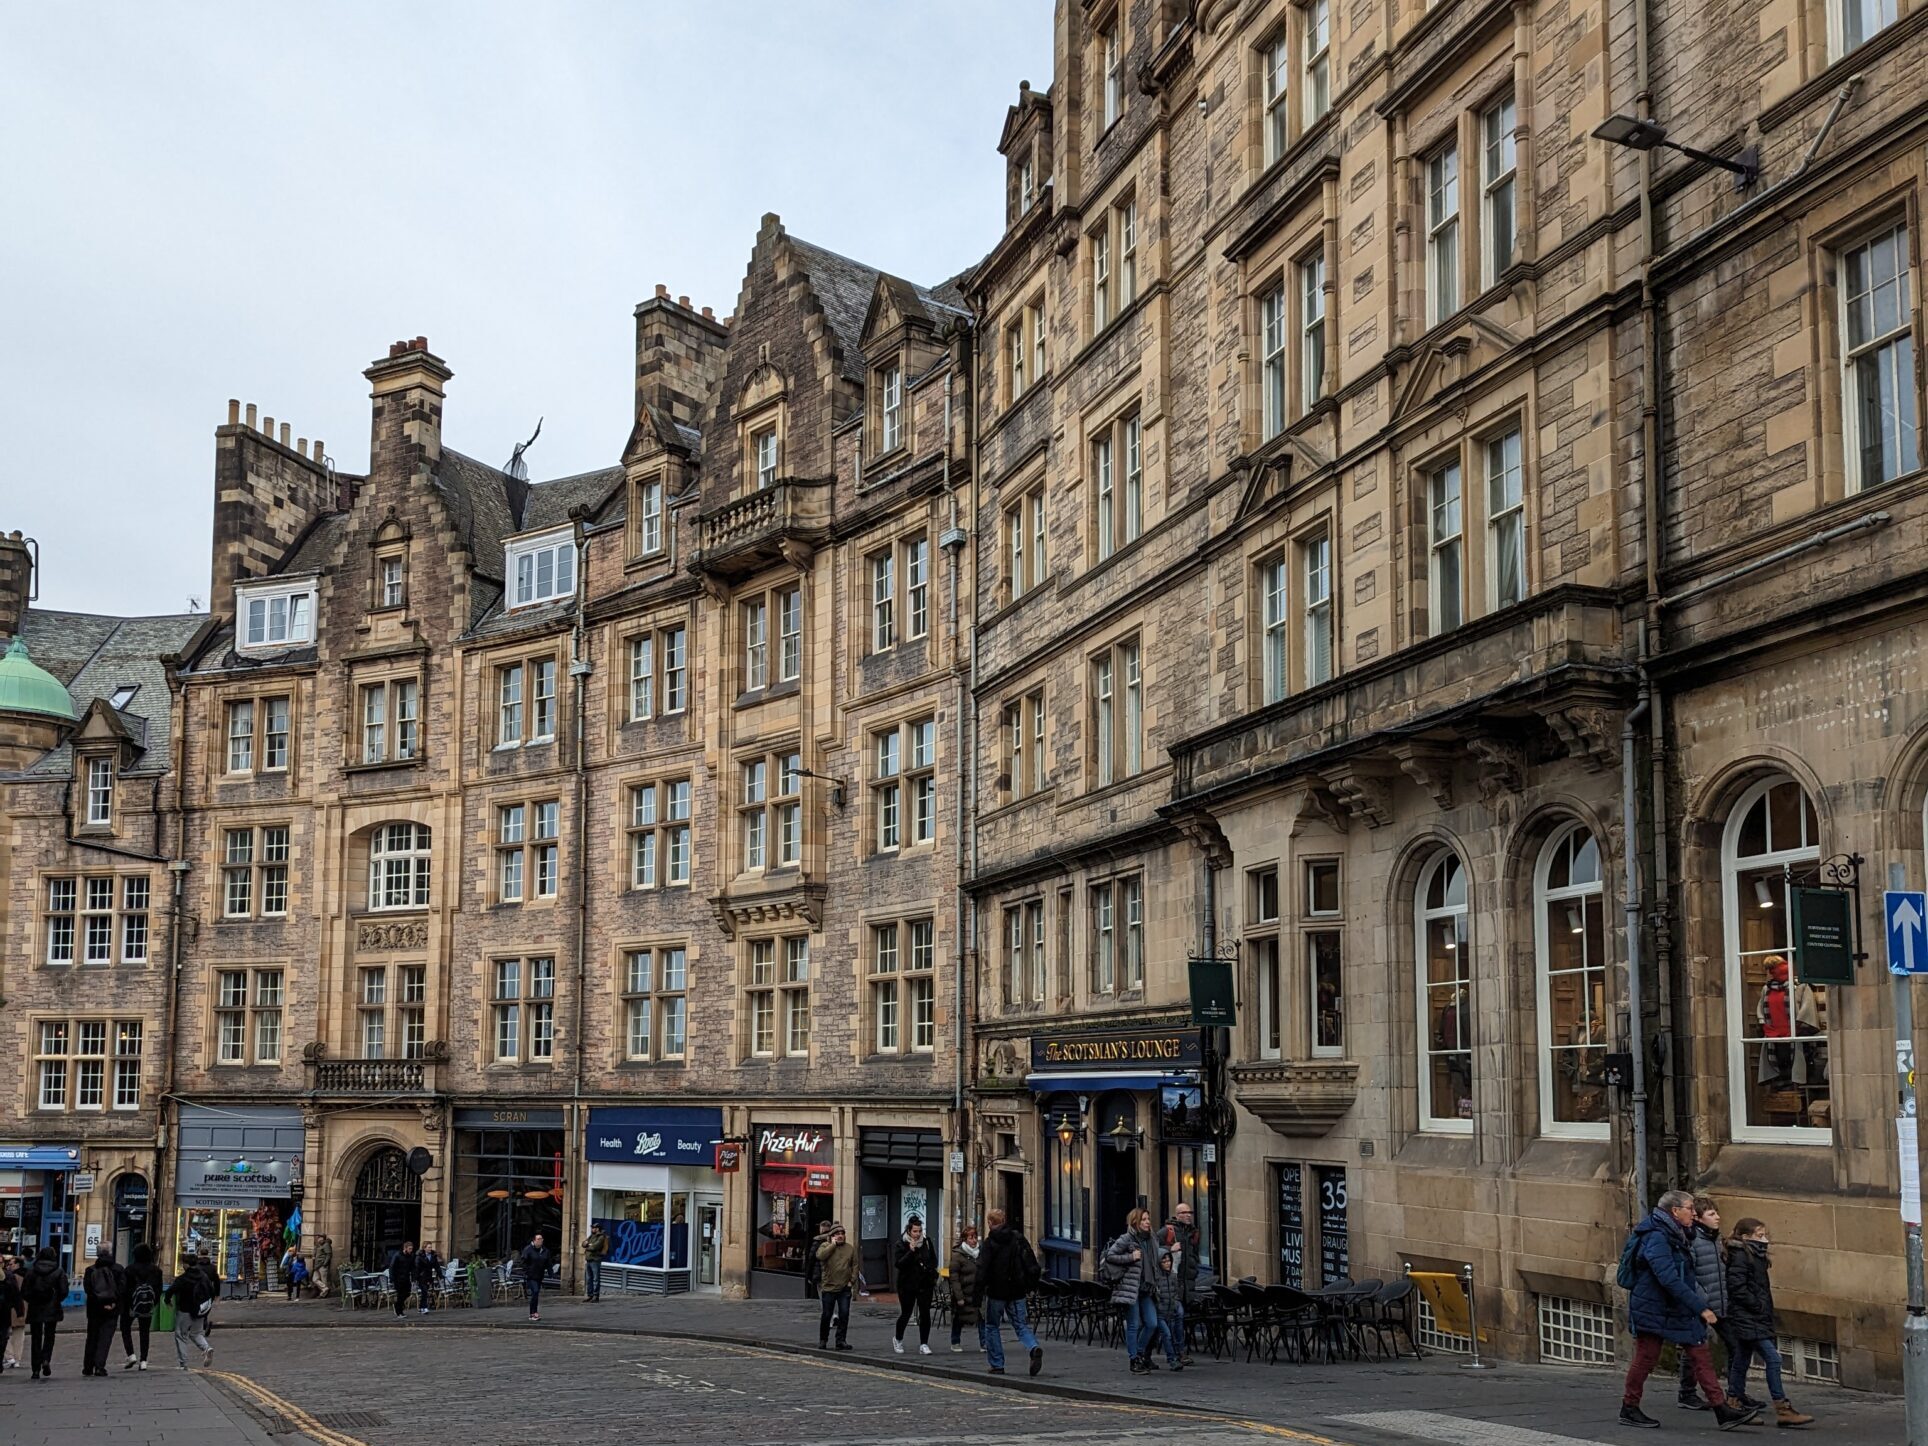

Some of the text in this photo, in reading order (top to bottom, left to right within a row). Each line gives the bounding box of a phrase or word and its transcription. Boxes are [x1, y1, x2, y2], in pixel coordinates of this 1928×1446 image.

[1046, 1039, 1181, 1061] The SCOTSMAN'S LOUNGE
[493, 1111, 528, 1121] SCRAN
[600, 1137, 622, 1148] Health
[634, 1132, 661, 1155] Boots
[677, 1139, 702, 1153] Beauty
[760, 1130, 823, 1153] Pizza Hut
[720, 1150, 738, 1160] Pizza
[721, 1159, 736, 1168] Hut
[233, 1173, 276, 1183] scottish
[1322, 1181, 1347, 1210] 35
[88, 1236, 99, 1246] 65
